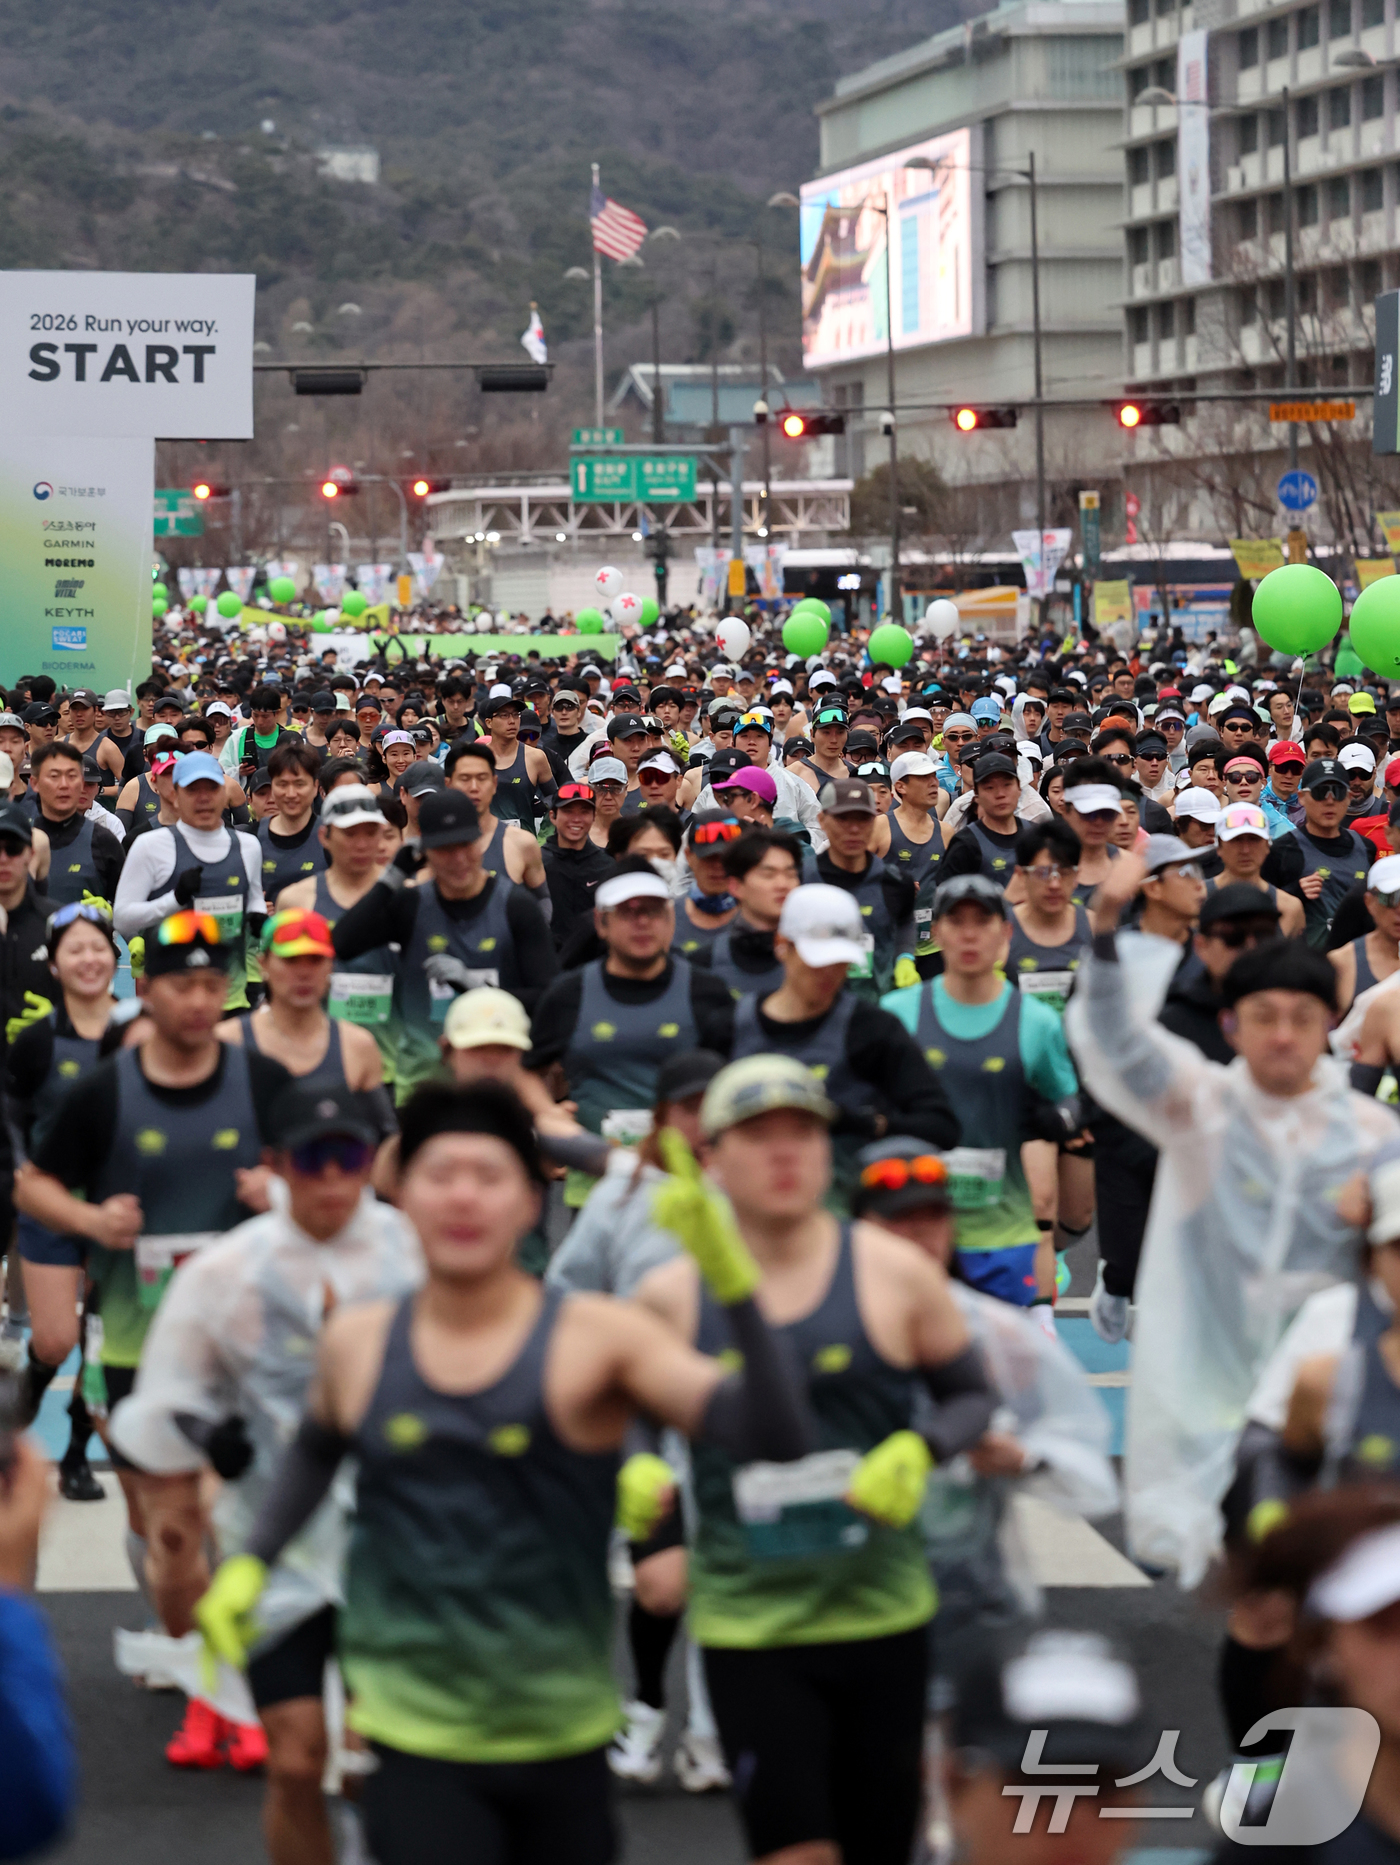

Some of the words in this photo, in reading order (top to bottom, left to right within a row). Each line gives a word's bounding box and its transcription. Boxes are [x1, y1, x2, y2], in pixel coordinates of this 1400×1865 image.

[30, 313, 78, 331] 2026
[84, 314, 122, 332] Run
[126, 318, 171, 336] your
[176, 319, 219, 337] way.
[28, 342, 216, 383] START
[58, 486, 106, 497] 국가보훈부
[43, 539, 95, 549] GARMIN
[45, 558, 95, 568] MOREMO
[44, 607, 95, 617] KEYTH
[42, 661, 96, 670] BIODERMA
